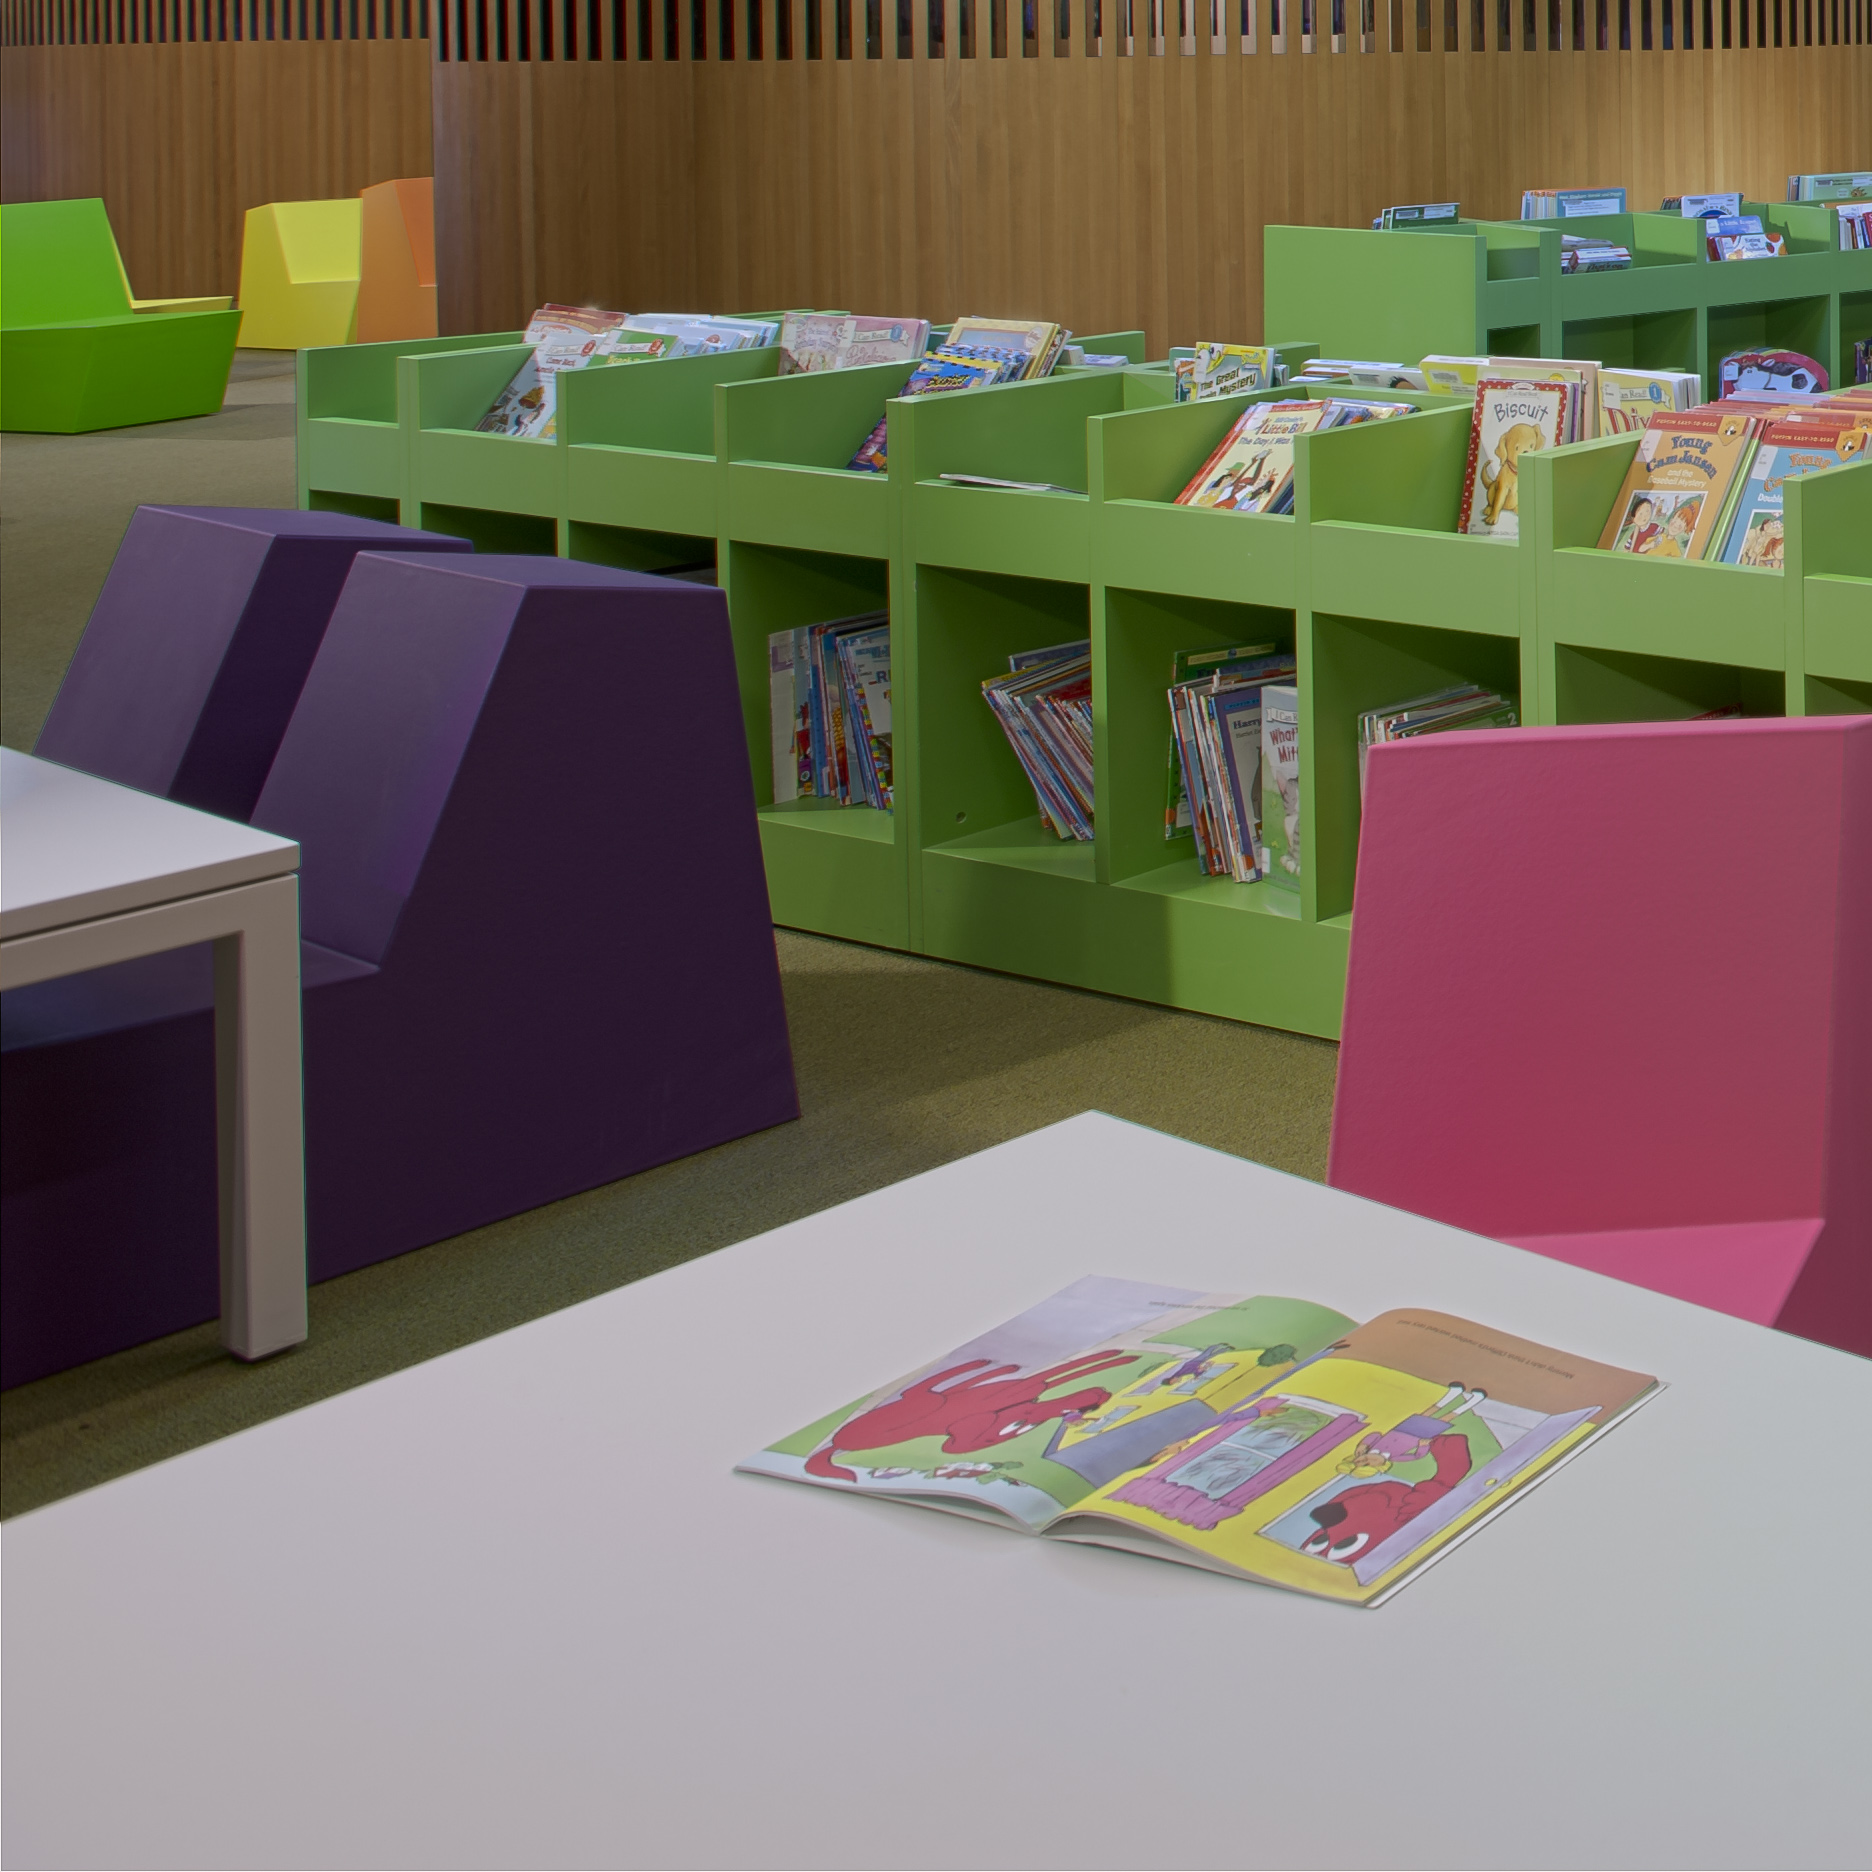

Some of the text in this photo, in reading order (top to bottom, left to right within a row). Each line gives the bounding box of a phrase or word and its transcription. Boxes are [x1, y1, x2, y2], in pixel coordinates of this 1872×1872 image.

[1216, 368, 1240, 385] Great
[1220, 373, 1257, 396] Mystery
[1494, 401, 1550, 424] Biscuit
[1671, 435, 1713, 455] Young
[1646, 450, 1718, 480] Cam Jansen
[1790, 452, 1833, 471] Young
[1667, 468, 1694, 477] and the
[1678, 478, 1707, 489] Mystery
